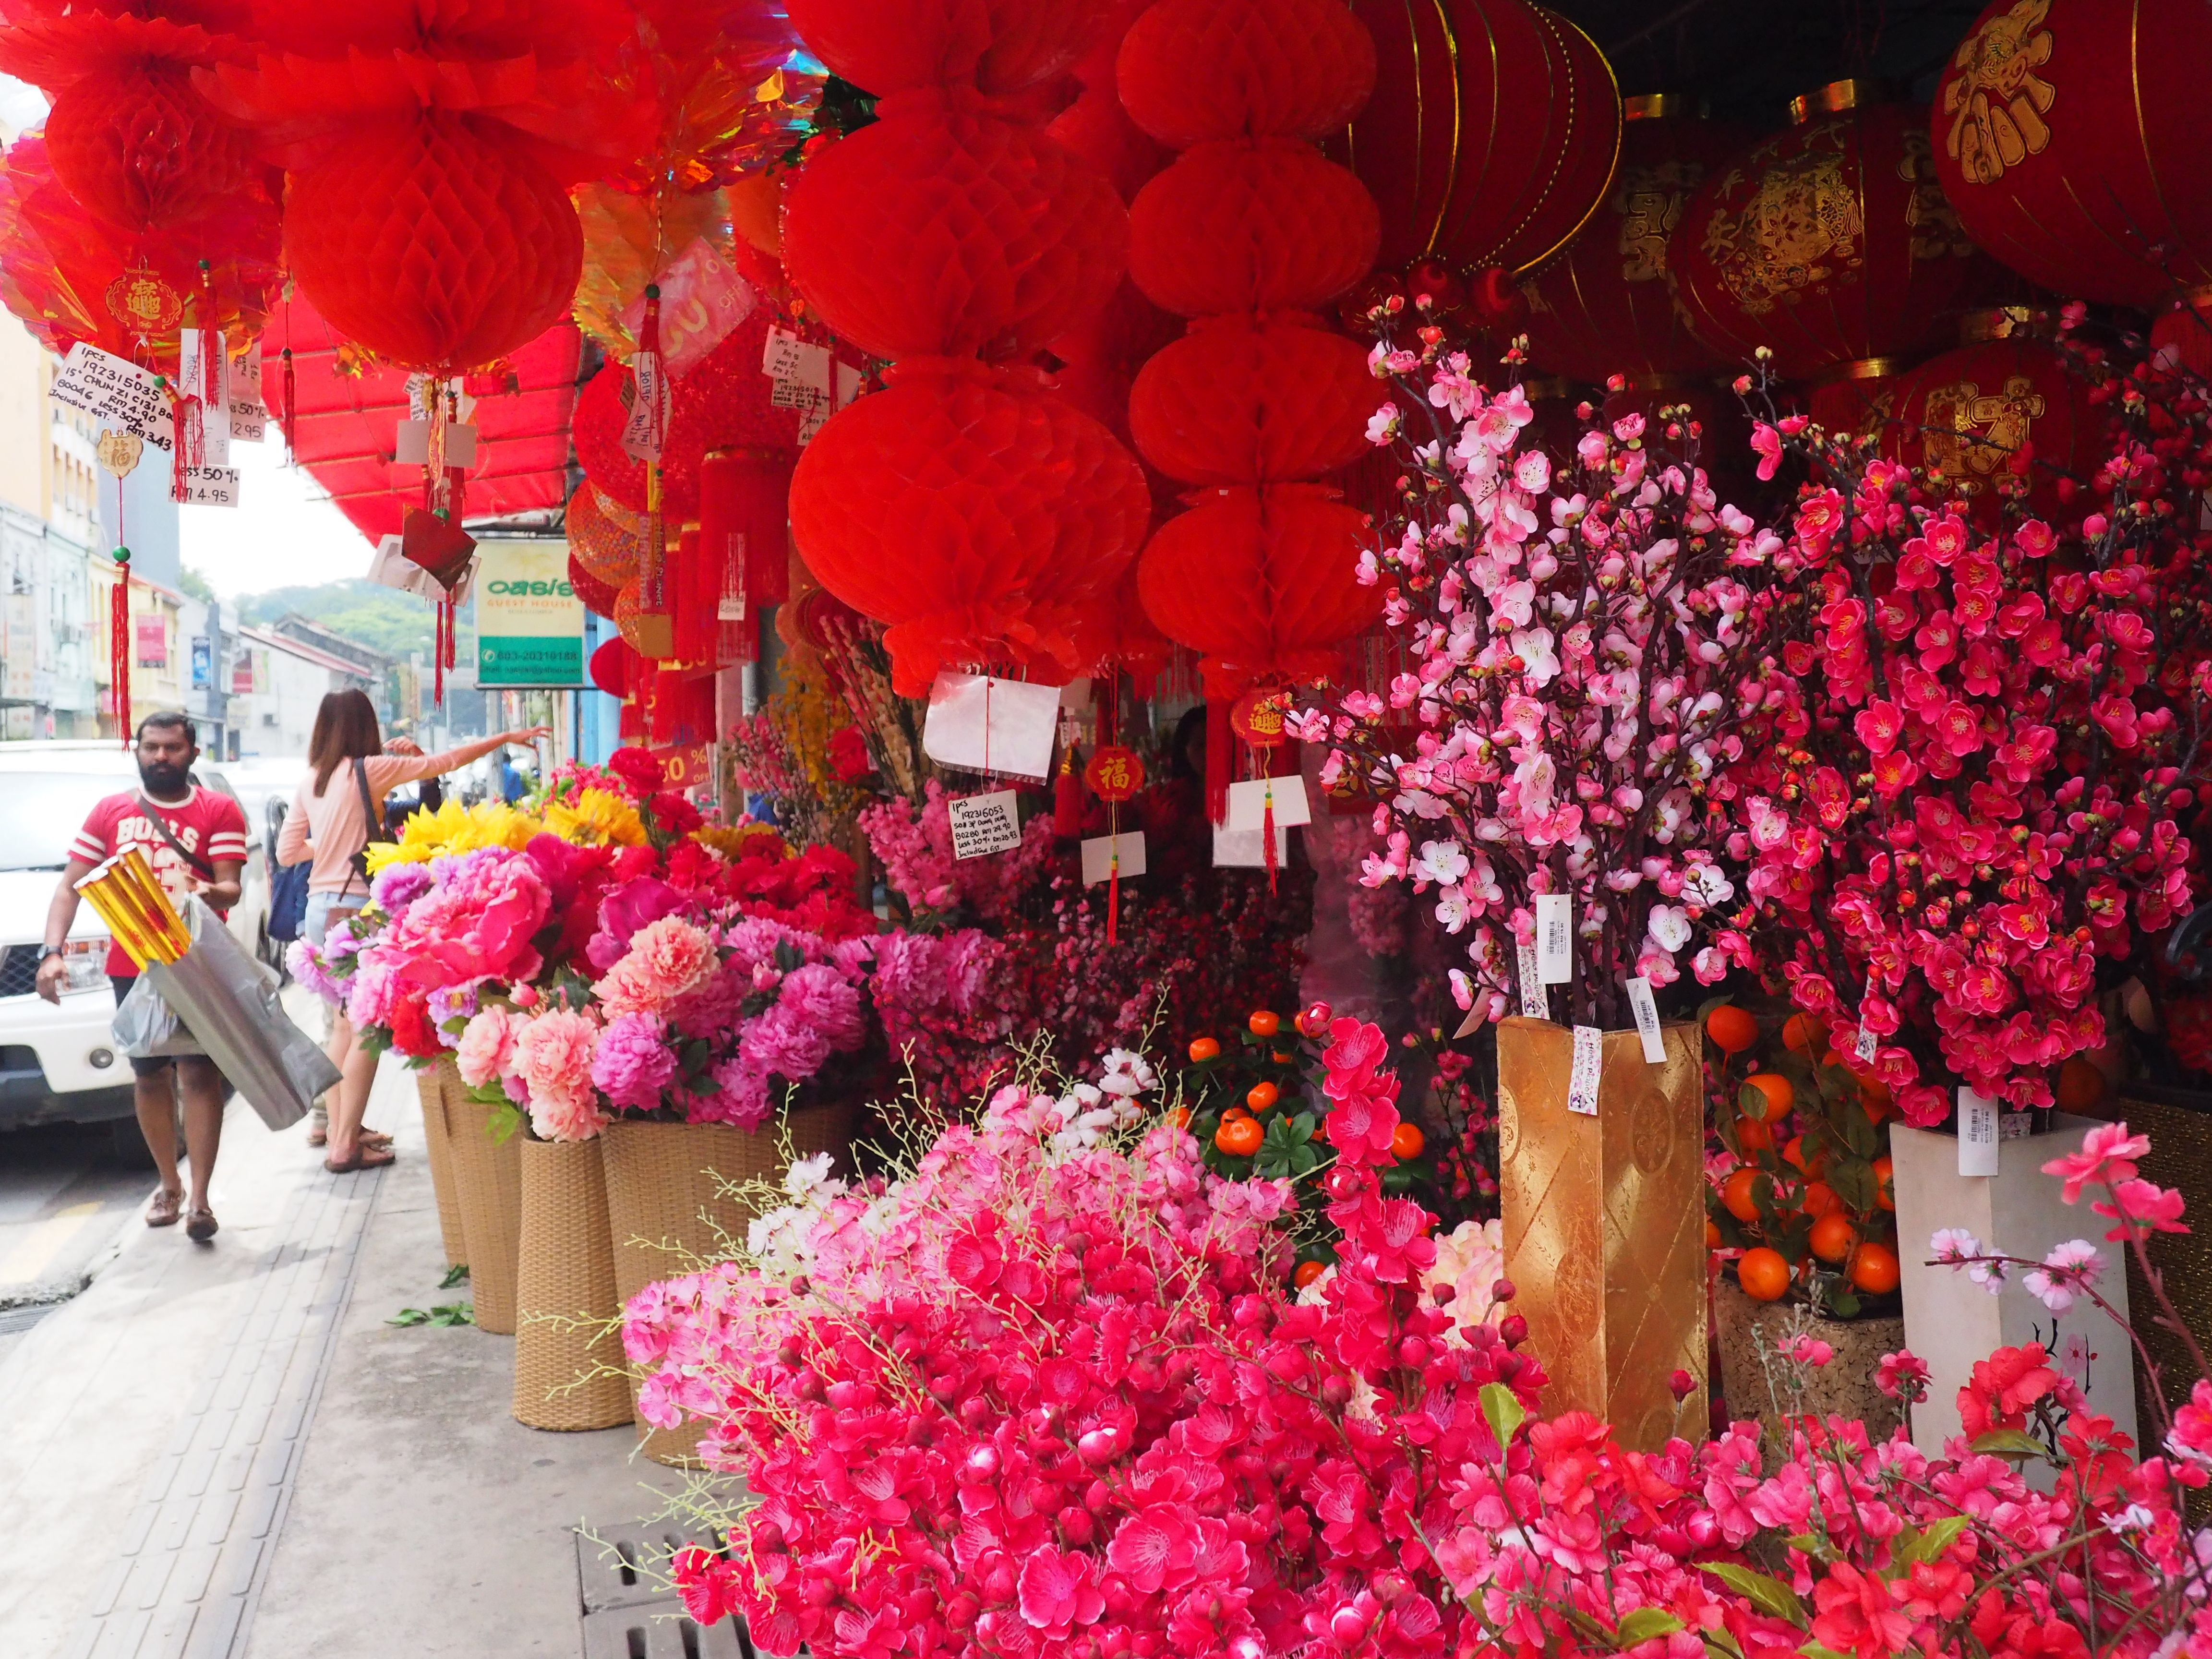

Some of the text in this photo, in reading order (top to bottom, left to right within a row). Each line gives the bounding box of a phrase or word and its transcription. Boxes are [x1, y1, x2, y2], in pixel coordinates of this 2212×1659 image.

[83, 361, 161, 402] 192315035
[84, 374, 115, 392] CHUN
[128, 406, 157, 423] 4.90
[239, 403, 265, 419] 50%
[202, 468, 239, 484] 50%
[197, 487, 229, 503] 4.95
[487, 599, 525, 607] GUEST
[1098, 757, 1129, 789] 福
[952, 800, 968, 814] 1pcs
[962, 805, 1004, 820] 192316053
